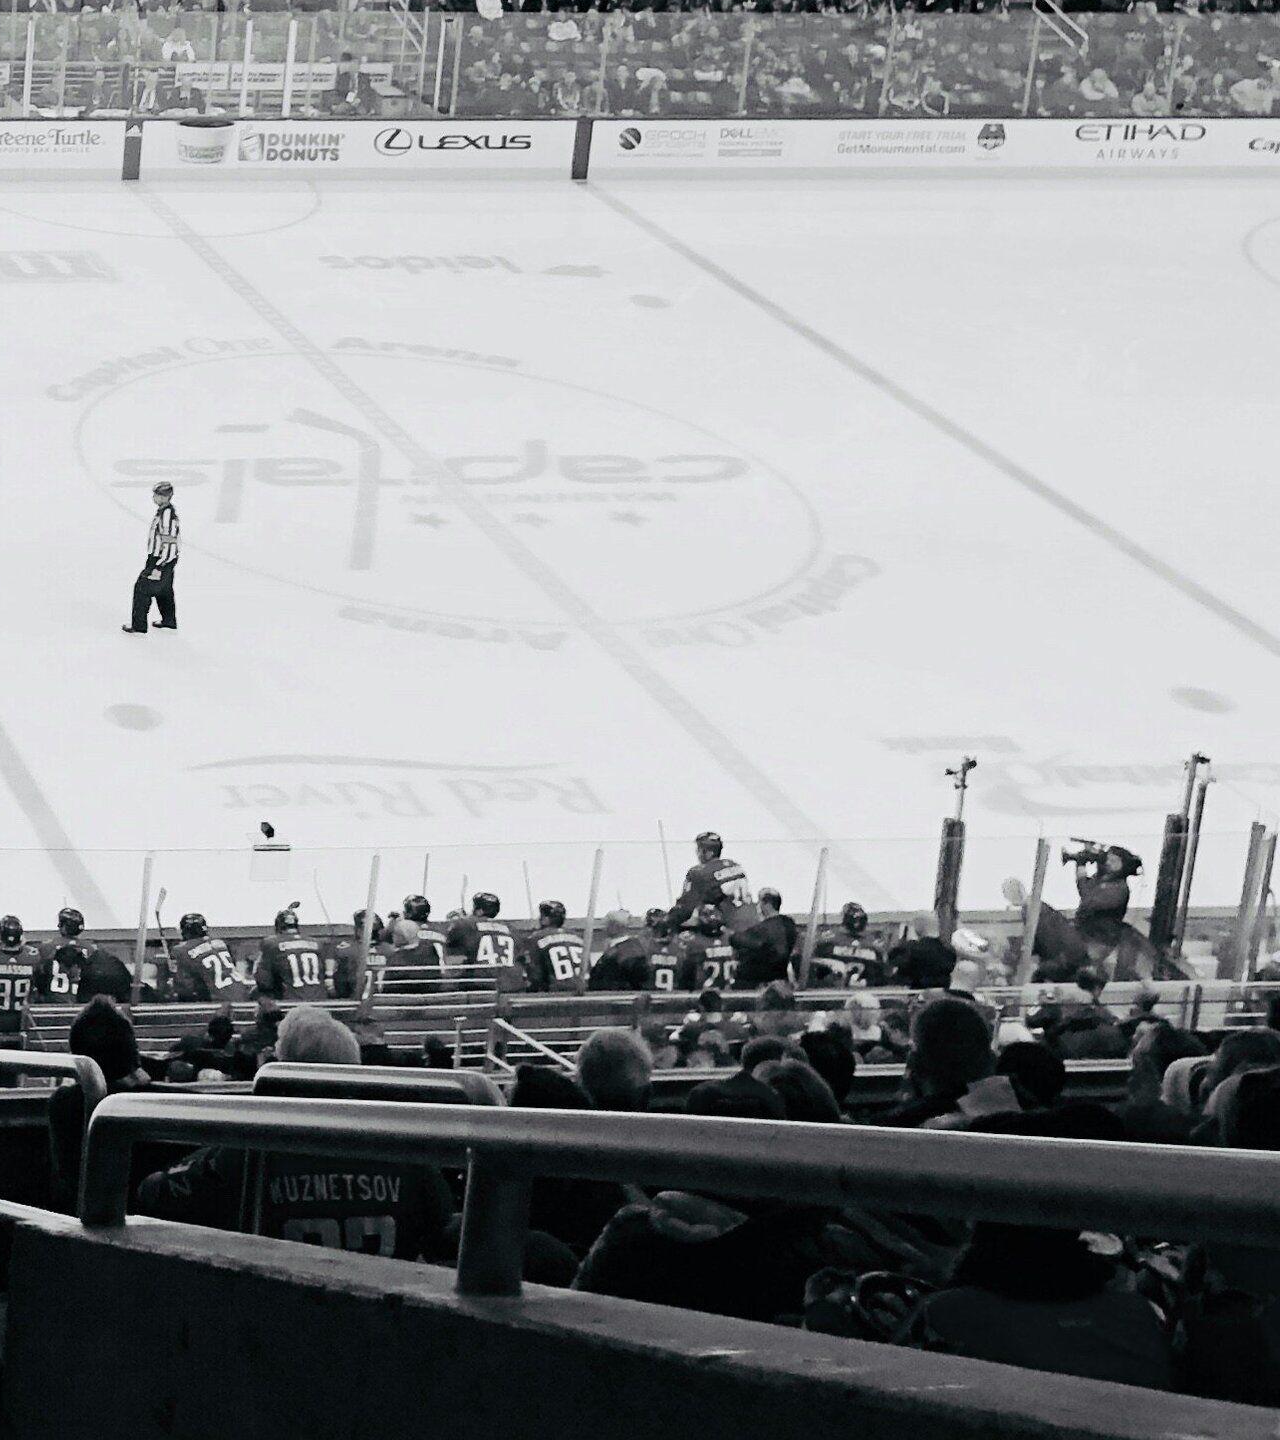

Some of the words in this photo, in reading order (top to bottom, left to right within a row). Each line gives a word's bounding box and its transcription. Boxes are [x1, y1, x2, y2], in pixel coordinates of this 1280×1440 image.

[48, 128, 101, 146] Turtle
[267, 131, 346, 146] DUNKIN'
[1075, 123, 1207, 141] ETIHAD
[417, 134, 532, 151] LEXUS
[265, 147, 340, 161] DONUTS
[1096, 148, 1180, 160] AIRWAYS
[435, 776, 609, 818] Red
[477, 935, 515, 966] 43
[286, 952, 321, 988] 10
[655, 968, 674, 992] 9
[270, 1173, 401, 1203] KUZNETSOV
